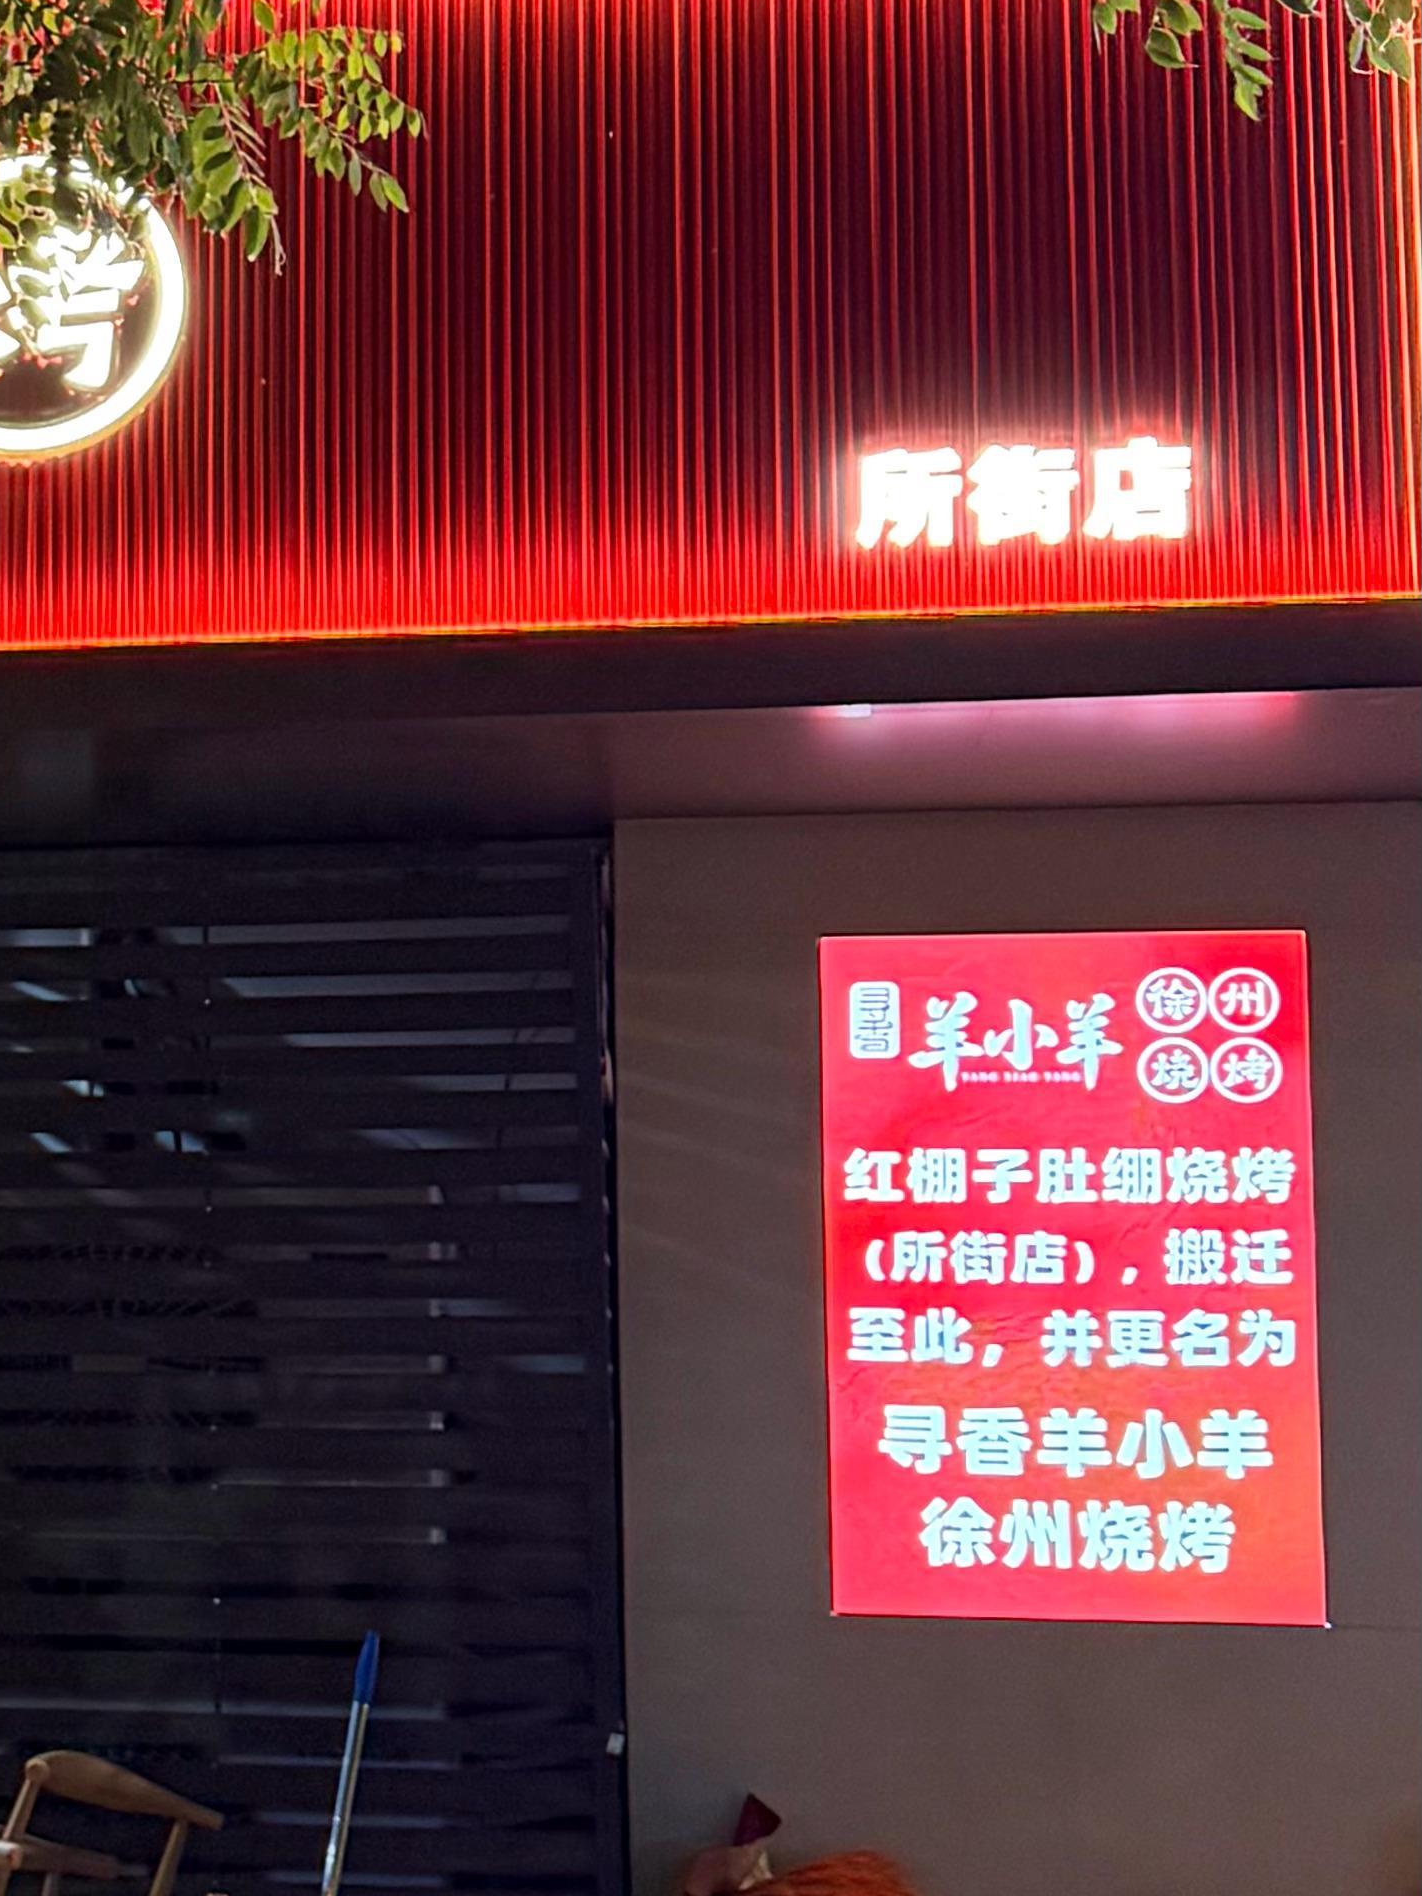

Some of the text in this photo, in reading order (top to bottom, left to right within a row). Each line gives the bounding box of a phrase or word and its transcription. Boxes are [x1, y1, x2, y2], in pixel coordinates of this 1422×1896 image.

[855, 437, 1192, 549] 所街店
[1140, 972, 1274, 1028] 徐州
[908, 991, 1123, 1092] 羊小羊
[1143, 1042, 1278, 1098] 烧烤
[843, 1147, 1297, 1205] 红棚子肚绷烧烤
[877, 1404, 1275, 1480] 寻香羊小羊
[918, 1497, 1236, 1575] 徐州烧烤
